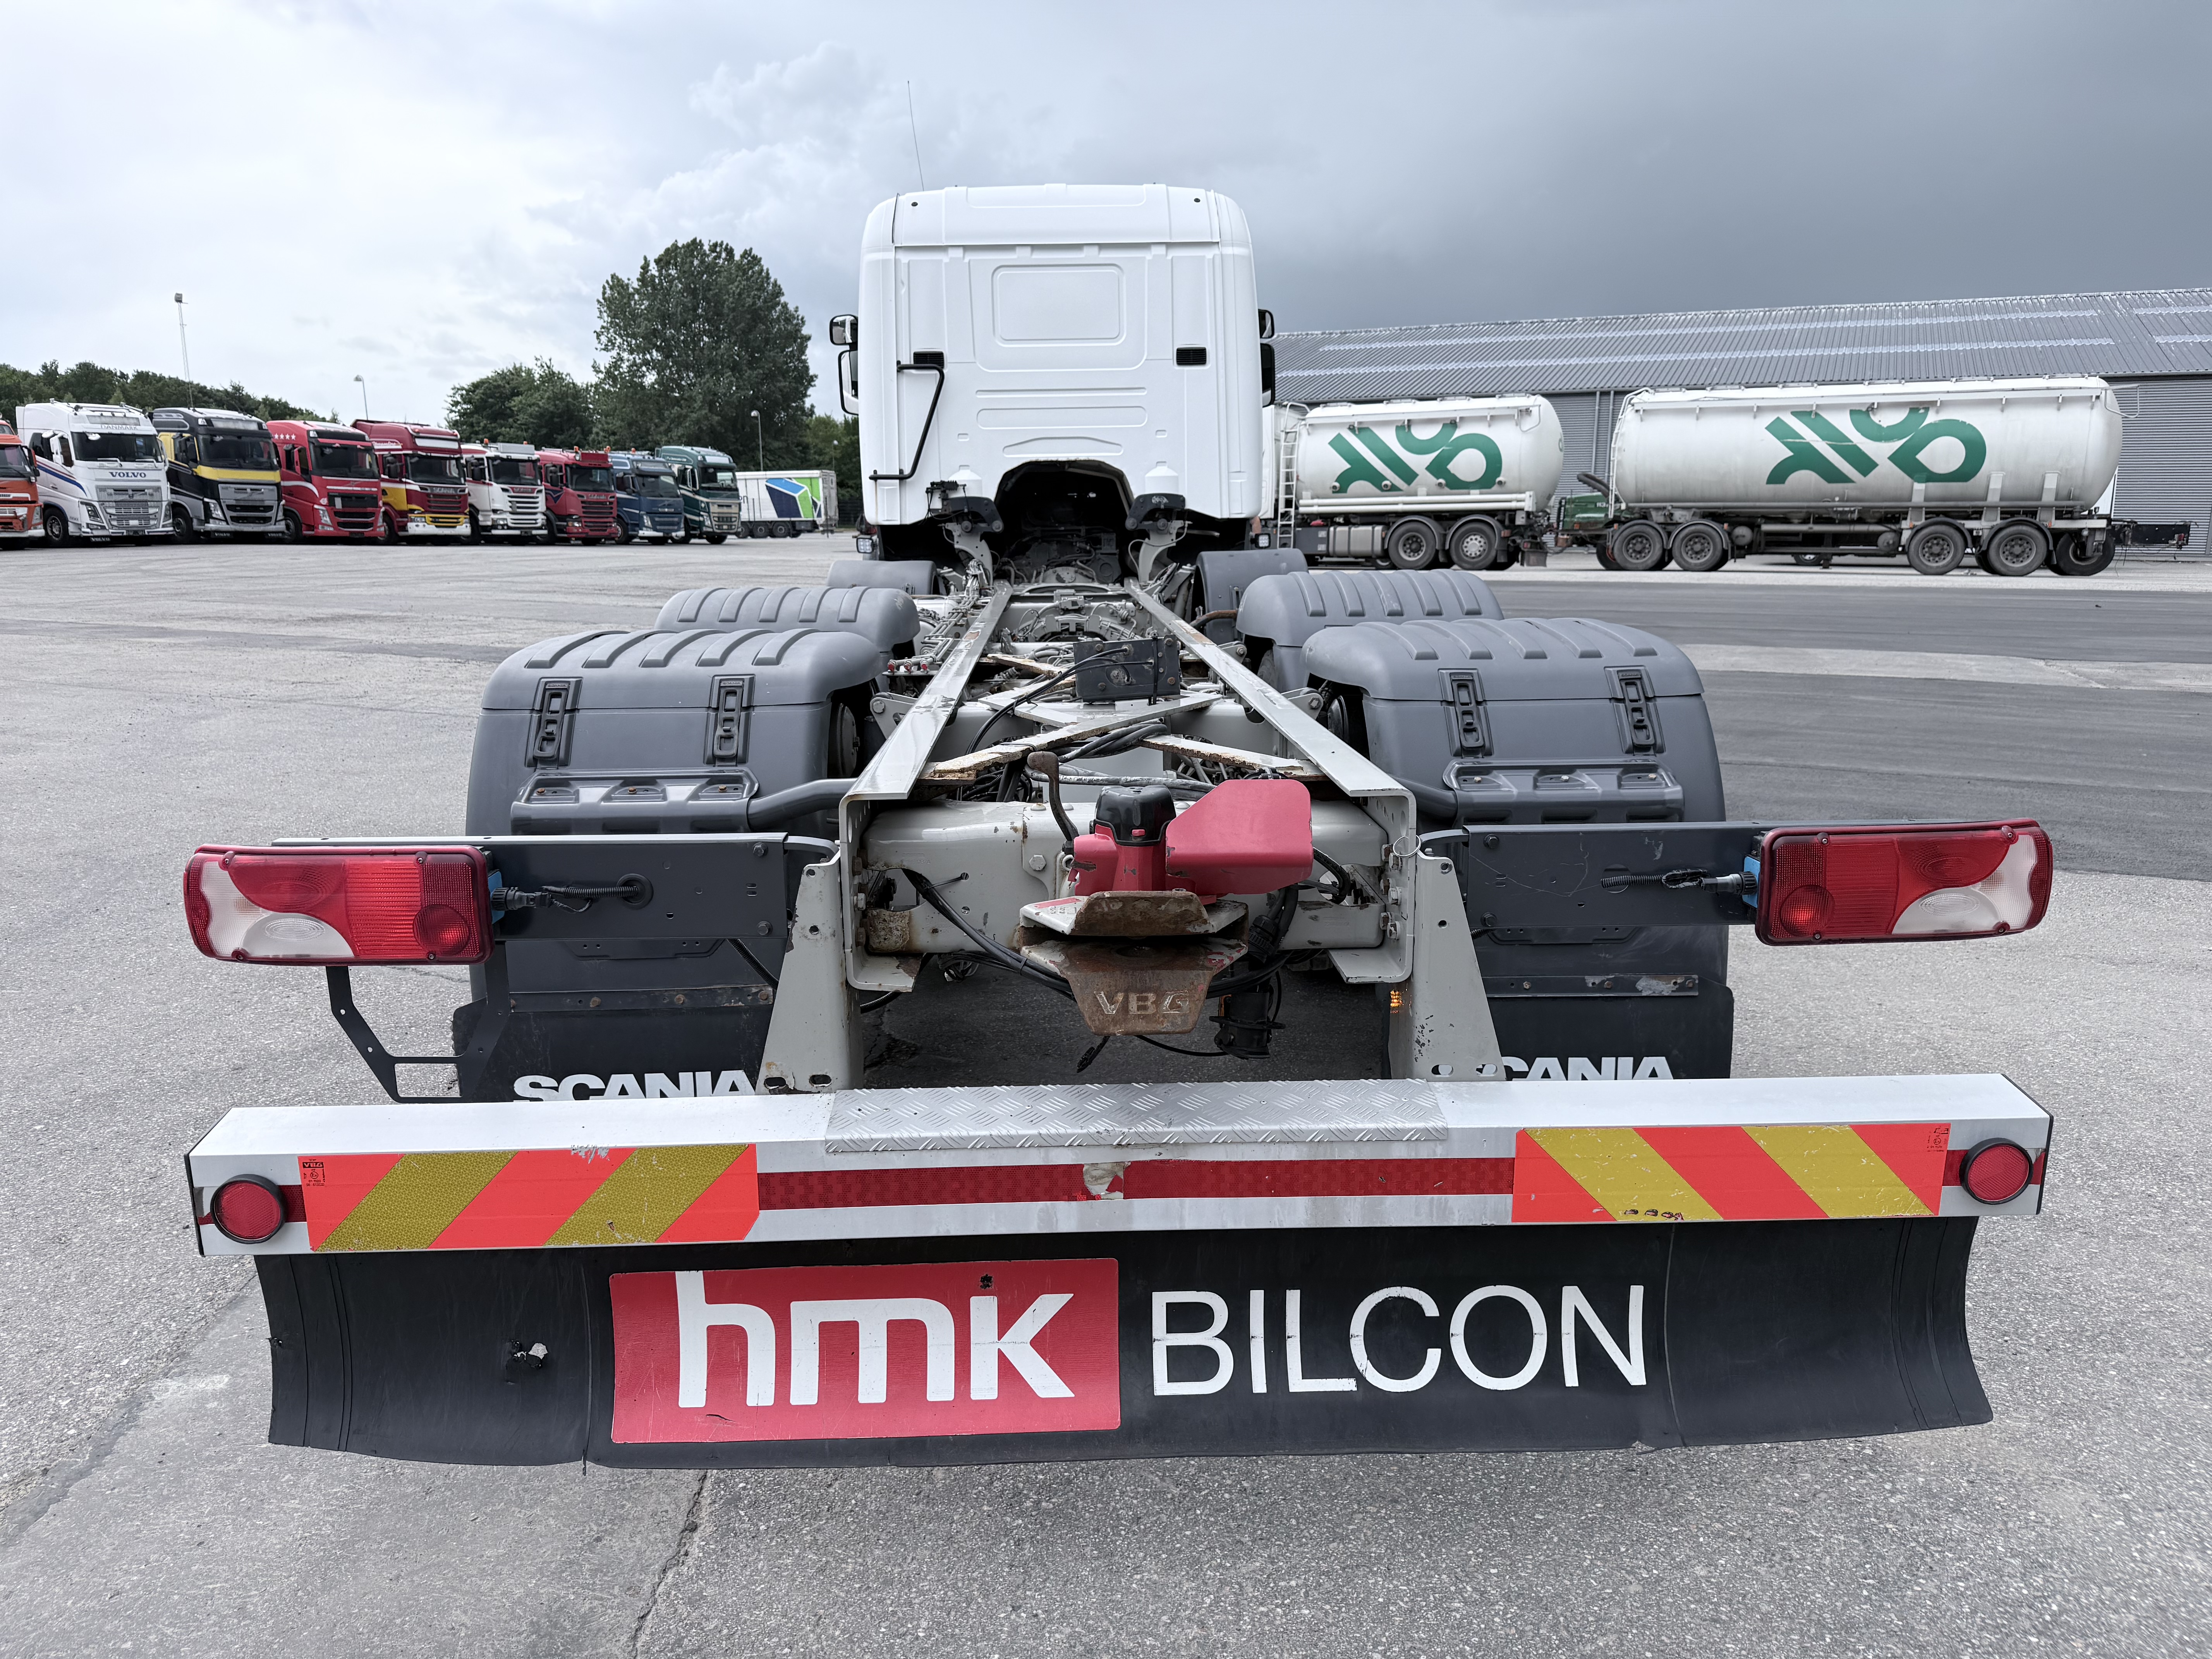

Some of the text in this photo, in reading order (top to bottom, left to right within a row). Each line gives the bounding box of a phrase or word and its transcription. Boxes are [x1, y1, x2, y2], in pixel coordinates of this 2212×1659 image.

[1094, 991, 1190, 1014] VBG
[1501, 1056, 1674, 1081] CANIA
[514, 1070, 756, 1102] SCANIA
[675, 1271, 1646, 1408] hmk BILCON
